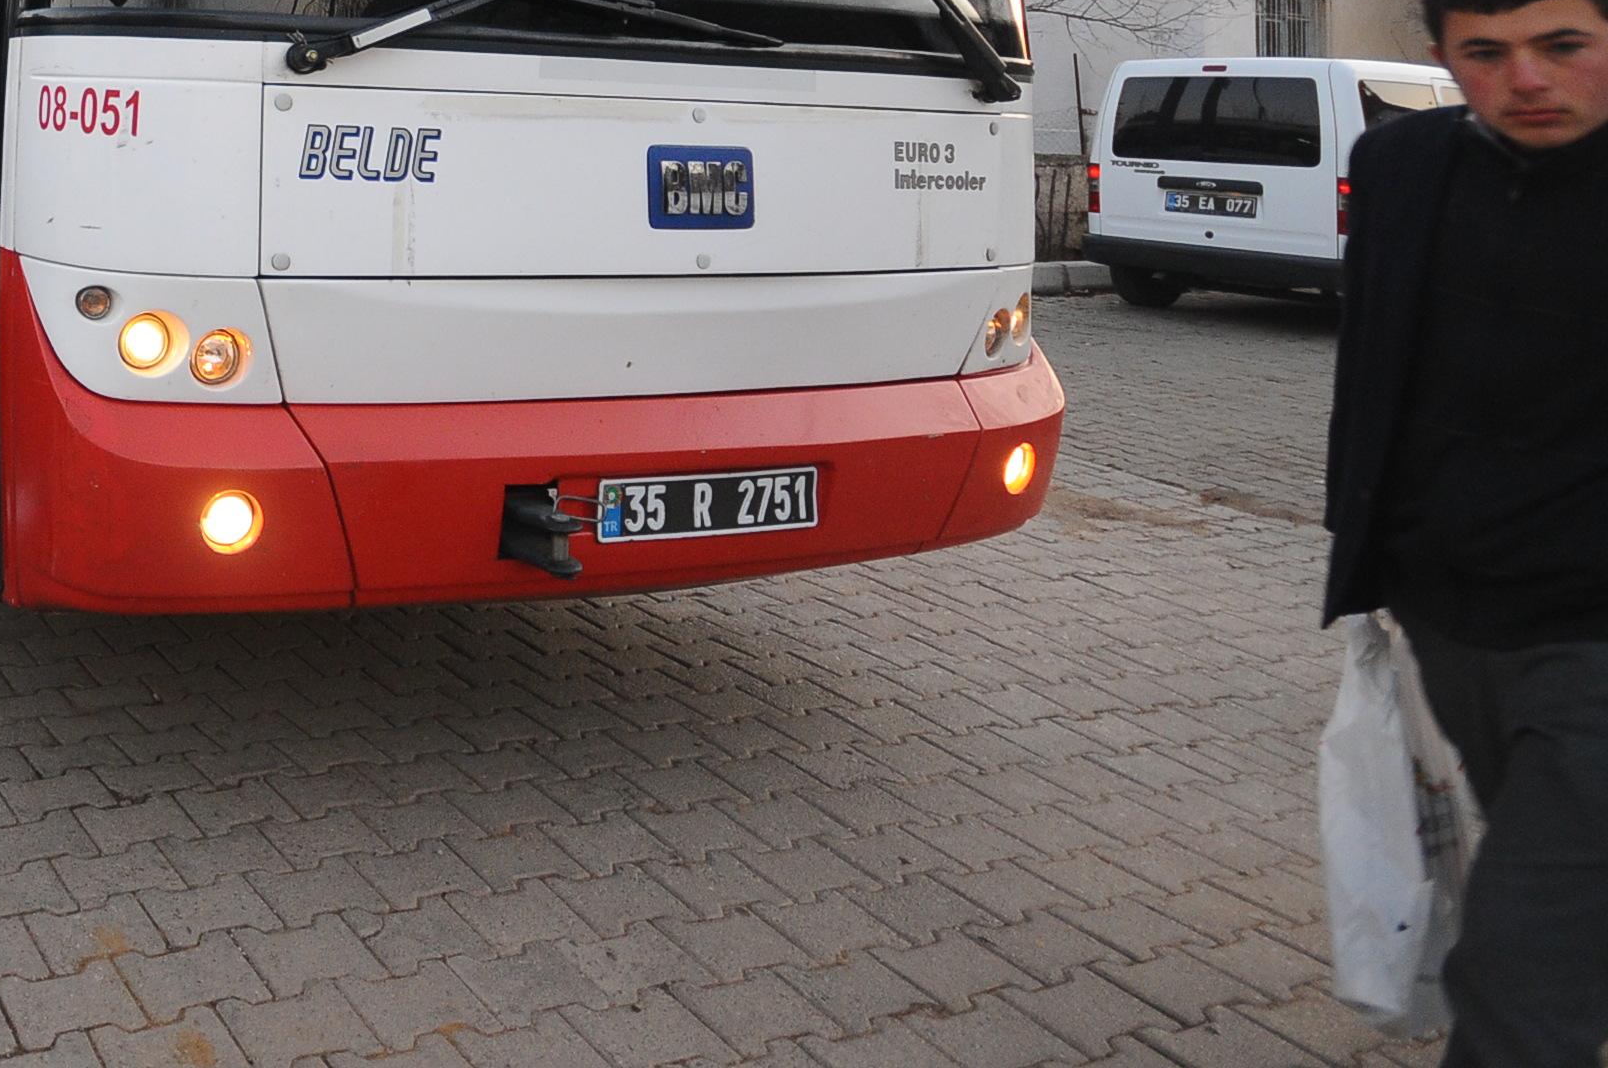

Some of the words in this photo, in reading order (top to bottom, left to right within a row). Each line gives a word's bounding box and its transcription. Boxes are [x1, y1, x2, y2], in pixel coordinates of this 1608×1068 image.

[38, 84, 141, 137] 08-051
[298, 123, 442, 183] BELDE
[894, 141, 939, 164] EURO
[944, 142, 956, 164] 3
[661, 159, 749, 216] BMC
[894, 168, 987, 191] Intercooler
[1175, 194, 1190, 208] 35
[1198, 196, 1215, 211] EA
[1225, 198, 1253, 214] 077
[624, 484, 667, 532] 35
[692, 482, 713, 529] R
[736, 475, 807, 525] 2751
[603, 520, 619, 533] TR
